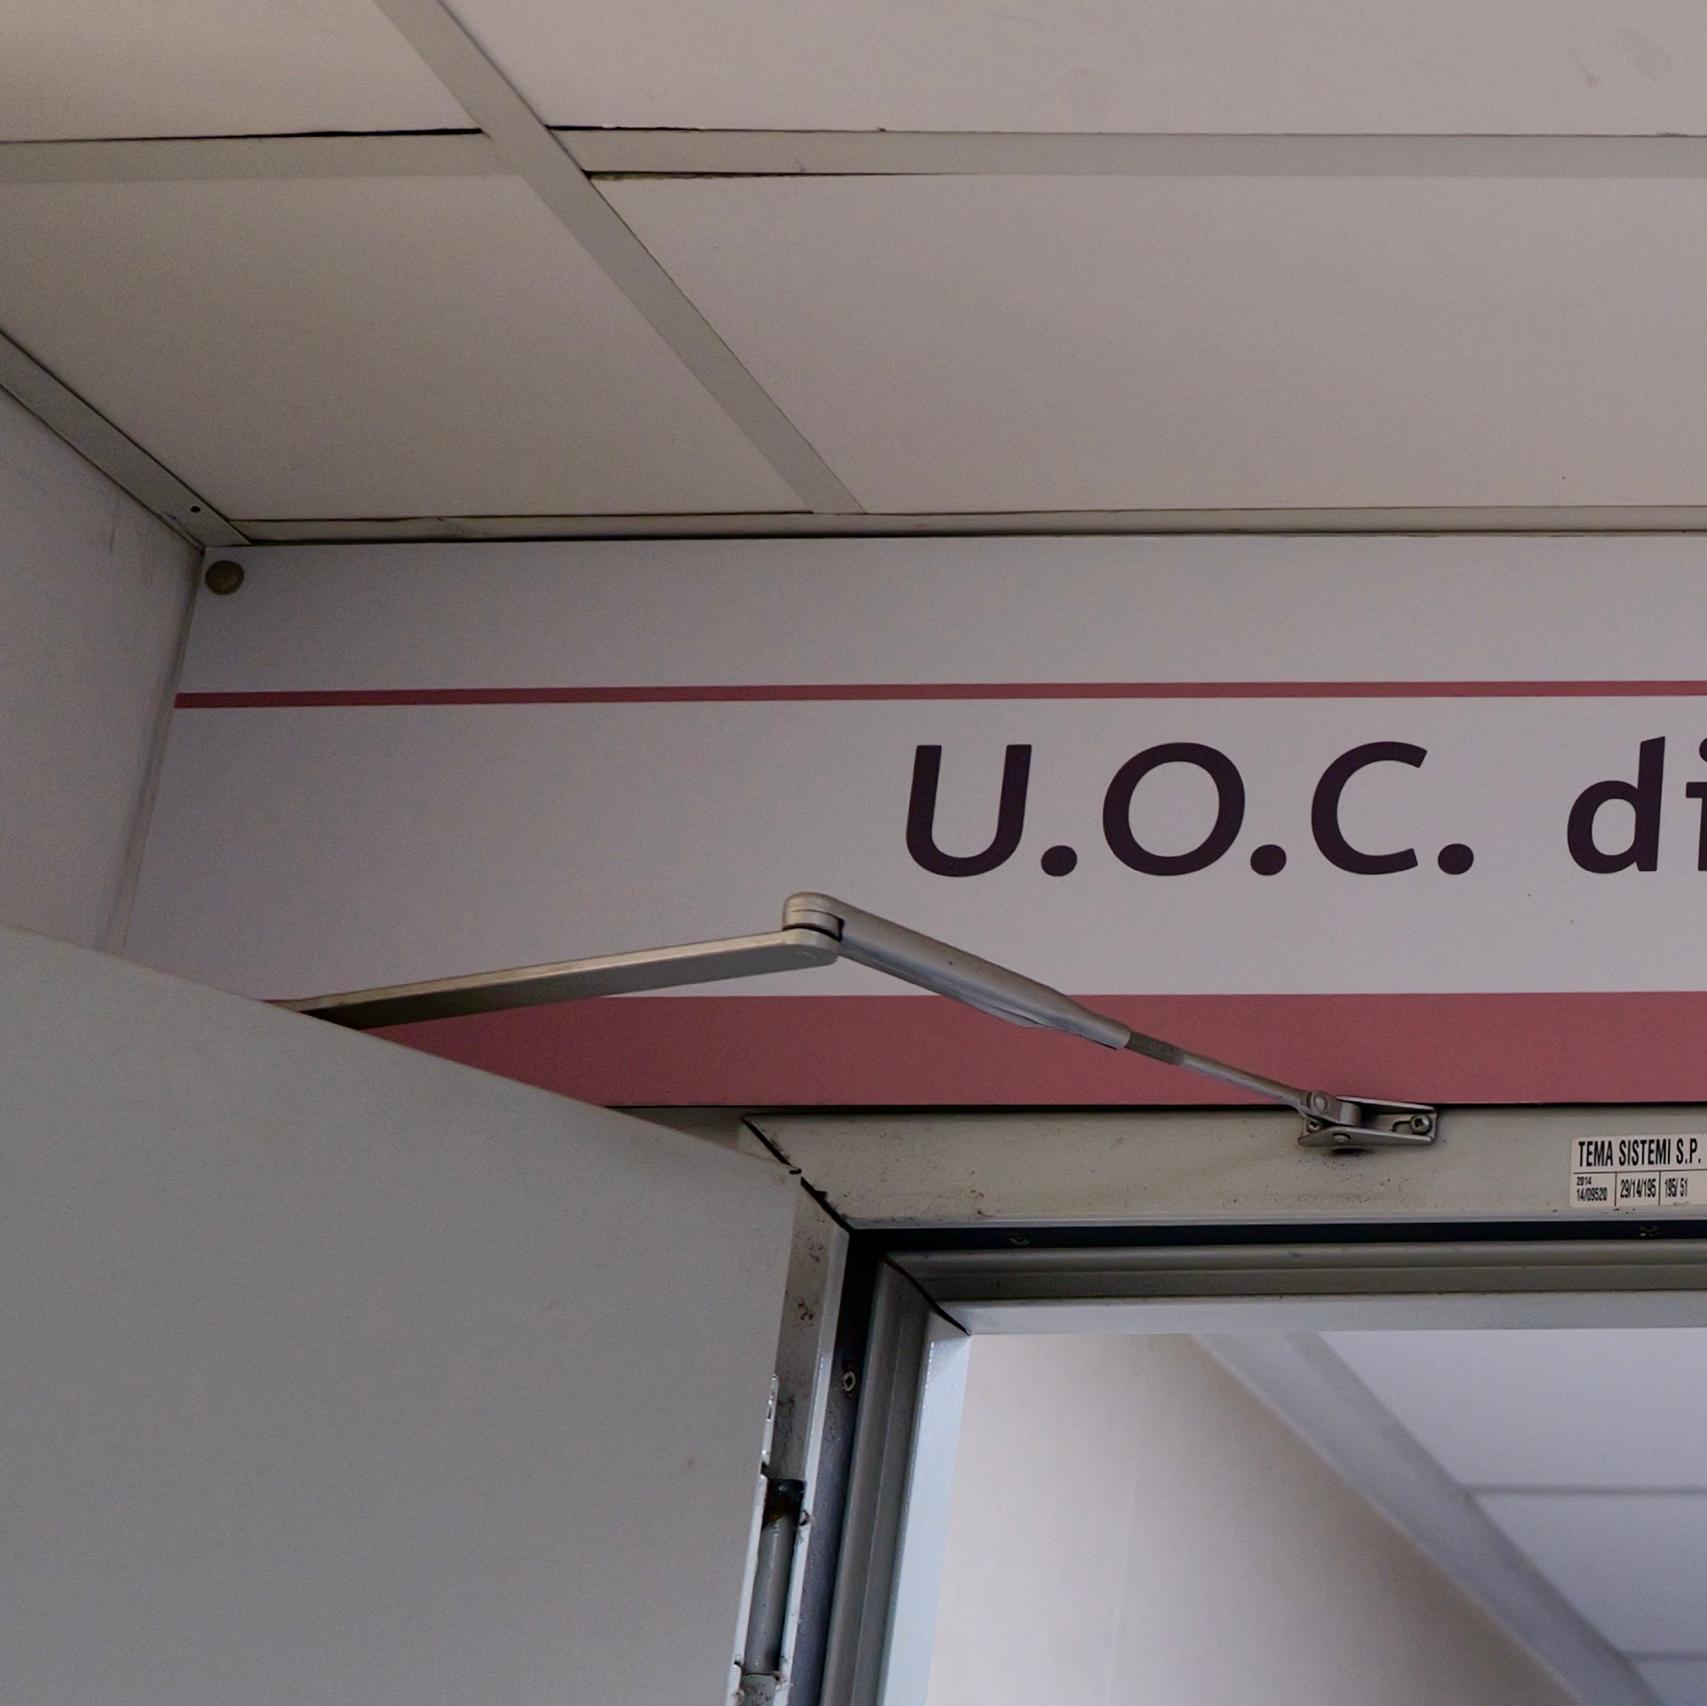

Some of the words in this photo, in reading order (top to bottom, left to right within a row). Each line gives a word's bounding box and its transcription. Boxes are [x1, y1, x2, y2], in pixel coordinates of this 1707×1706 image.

[905, 741, 1475, 878] U.O.C.
[1578, 1140, 1614, 1167] TEMA
[1618, 1138, 1671, 1166] SISTEMI
[1676, 1137, 1701, 1164] S.P.
[1576, 1176, 1592, 1186] 2014
